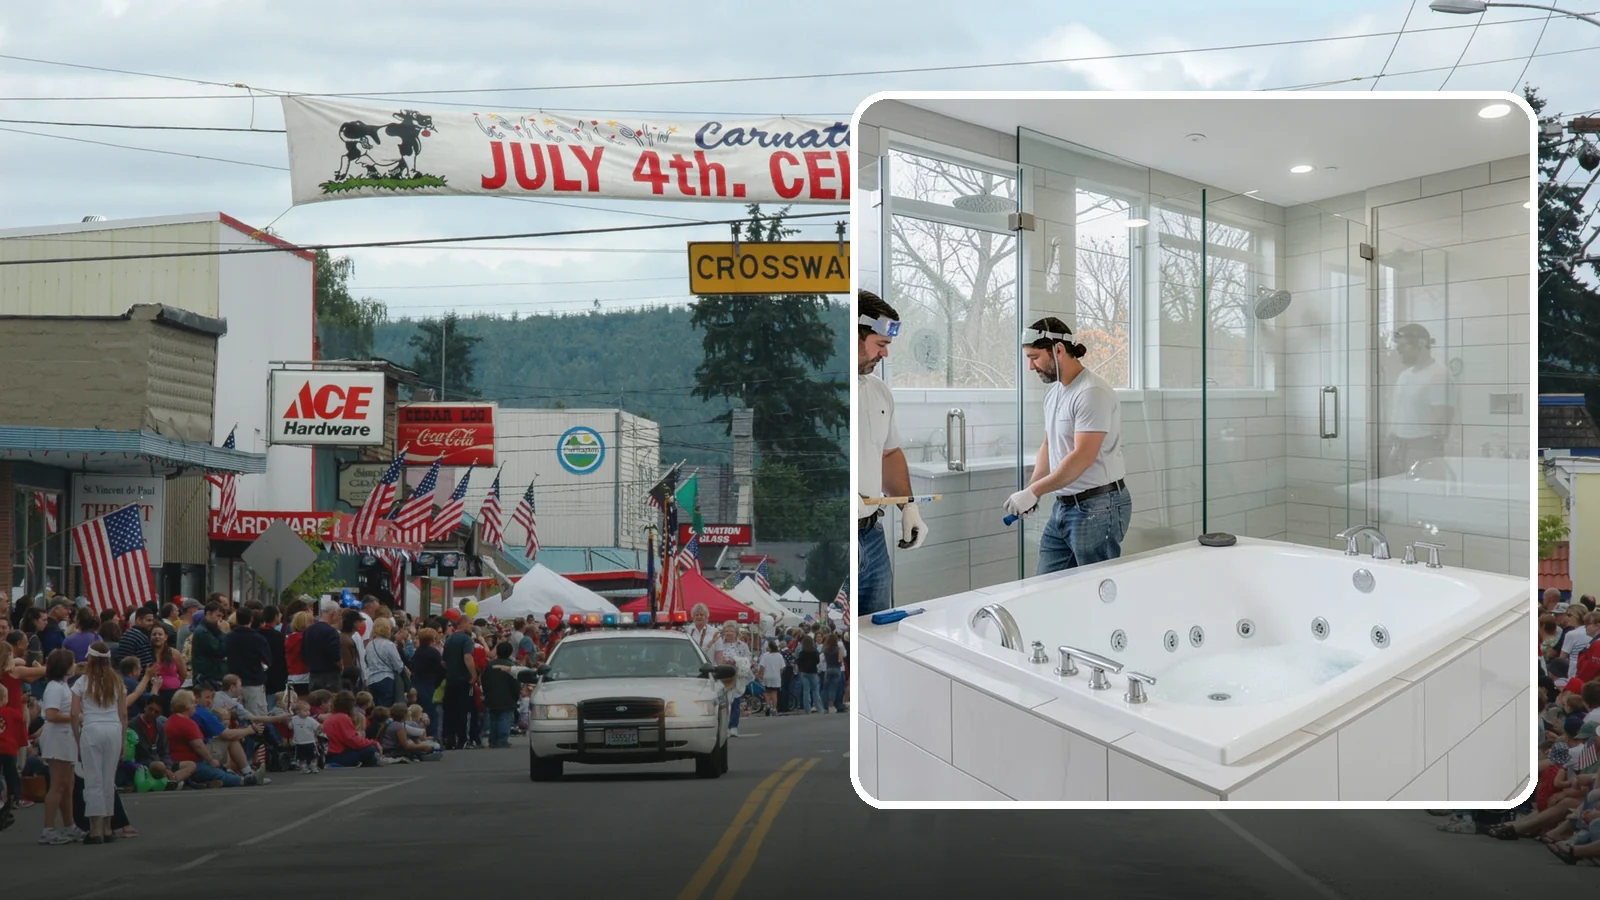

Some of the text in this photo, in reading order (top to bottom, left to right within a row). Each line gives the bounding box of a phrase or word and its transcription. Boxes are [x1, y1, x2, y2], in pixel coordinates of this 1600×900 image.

[695, 121, 850, 149] Carnat
[481, 141, 605, 192] JULY
[632, 150, 746, 197] 4th.
[697, 254, 850, 280] CROSSWA
[283, 380, 373, 420] ACE
[406, 409, 453, 423] CEDAR
[283, 421, 370, 436] Hardware
[95, 484, 124, 495] Vincent
[126, 485, 136, 495] de
[137, 485, 155, 495] Paul
[212, 515, 331, 536] HARDARE
[688, 526, 741, 535] CRNATION
[699, 535, 730, 544] GLASS
